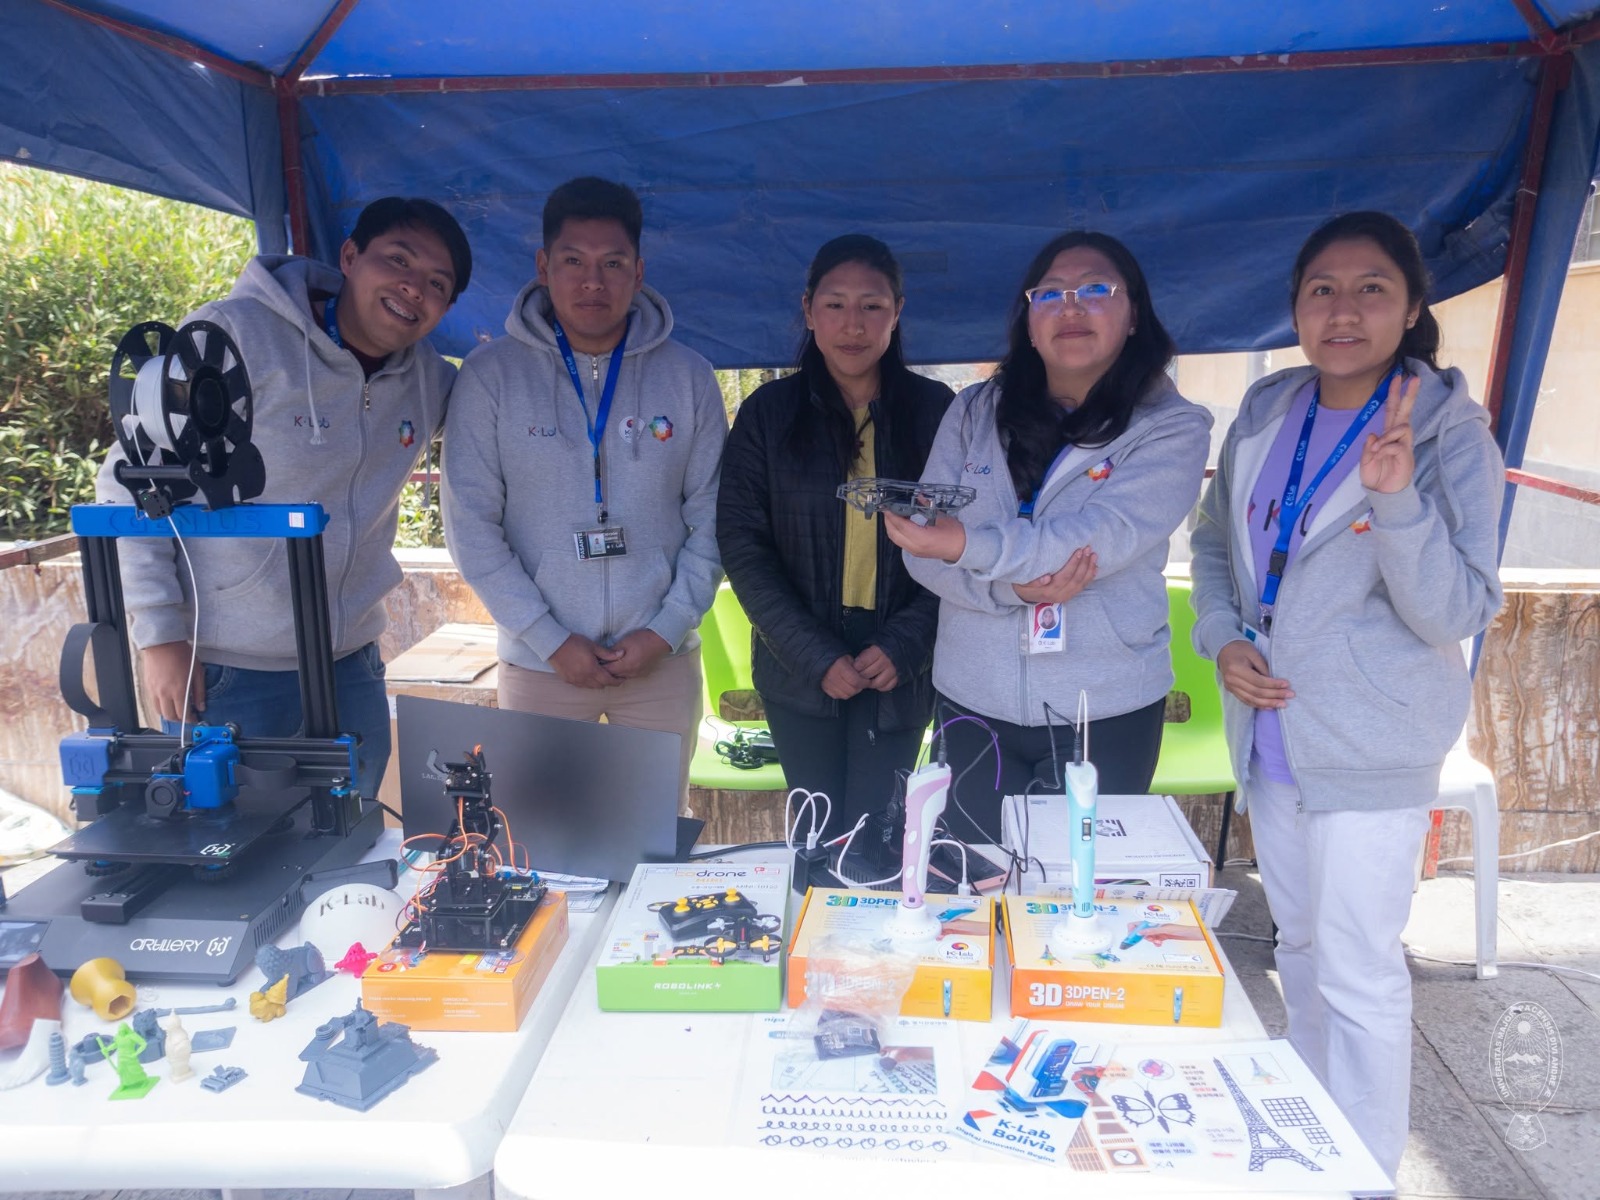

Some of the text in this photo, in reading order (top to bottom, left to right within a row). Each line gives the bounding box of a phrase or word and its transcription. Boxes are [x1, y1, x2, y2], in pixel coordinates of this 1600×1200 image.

[963, 462, 992, 475] K-Lab
[319, 892, 385, 916] K-Lab
[1025, 902, 1059, 915] 3D
[1028, 982, 1126, 1007] 3D 3DPEN-2
[955, 1126, 981, 1142] Digital
[998, 1119, 1051, 1139] K-Lab
[992, 1128, 1056, 1153] Bolivia
